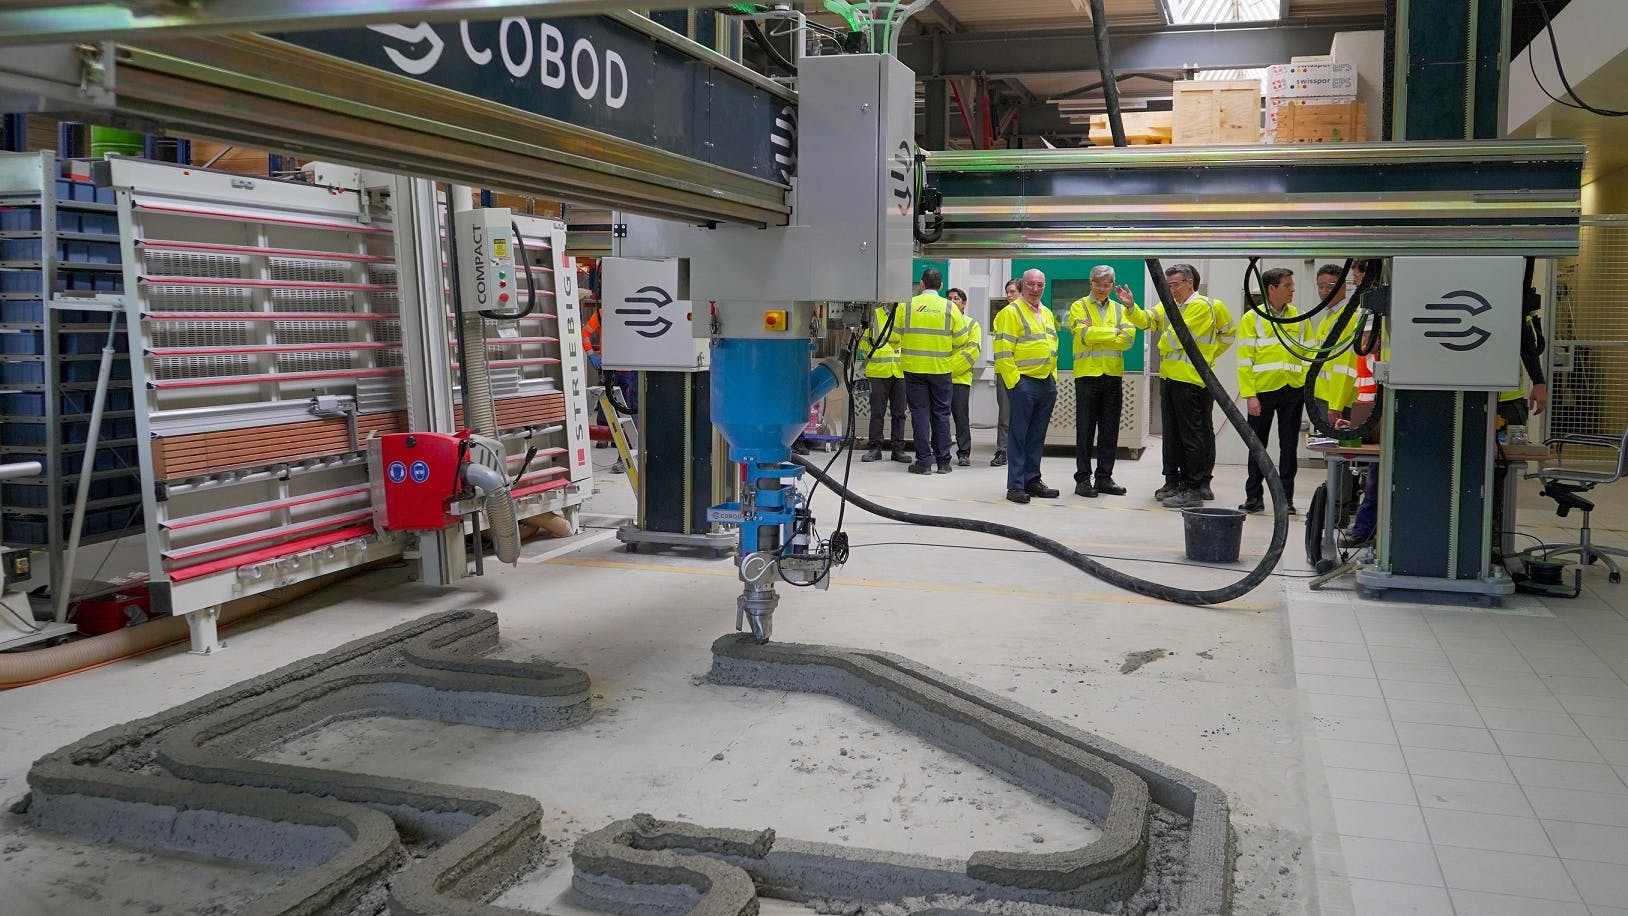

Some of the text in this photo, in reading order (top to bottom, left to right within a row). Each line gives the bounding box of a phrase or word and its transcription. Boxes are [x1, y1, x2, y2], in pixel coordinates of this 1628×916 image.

[459, 17, 629, 109] COBOD
[1295, 77, 1331, 85] swisspor
[472, 224, 487, 305] COMPACT
[563, 275, 584, 441] STRIEBIG
